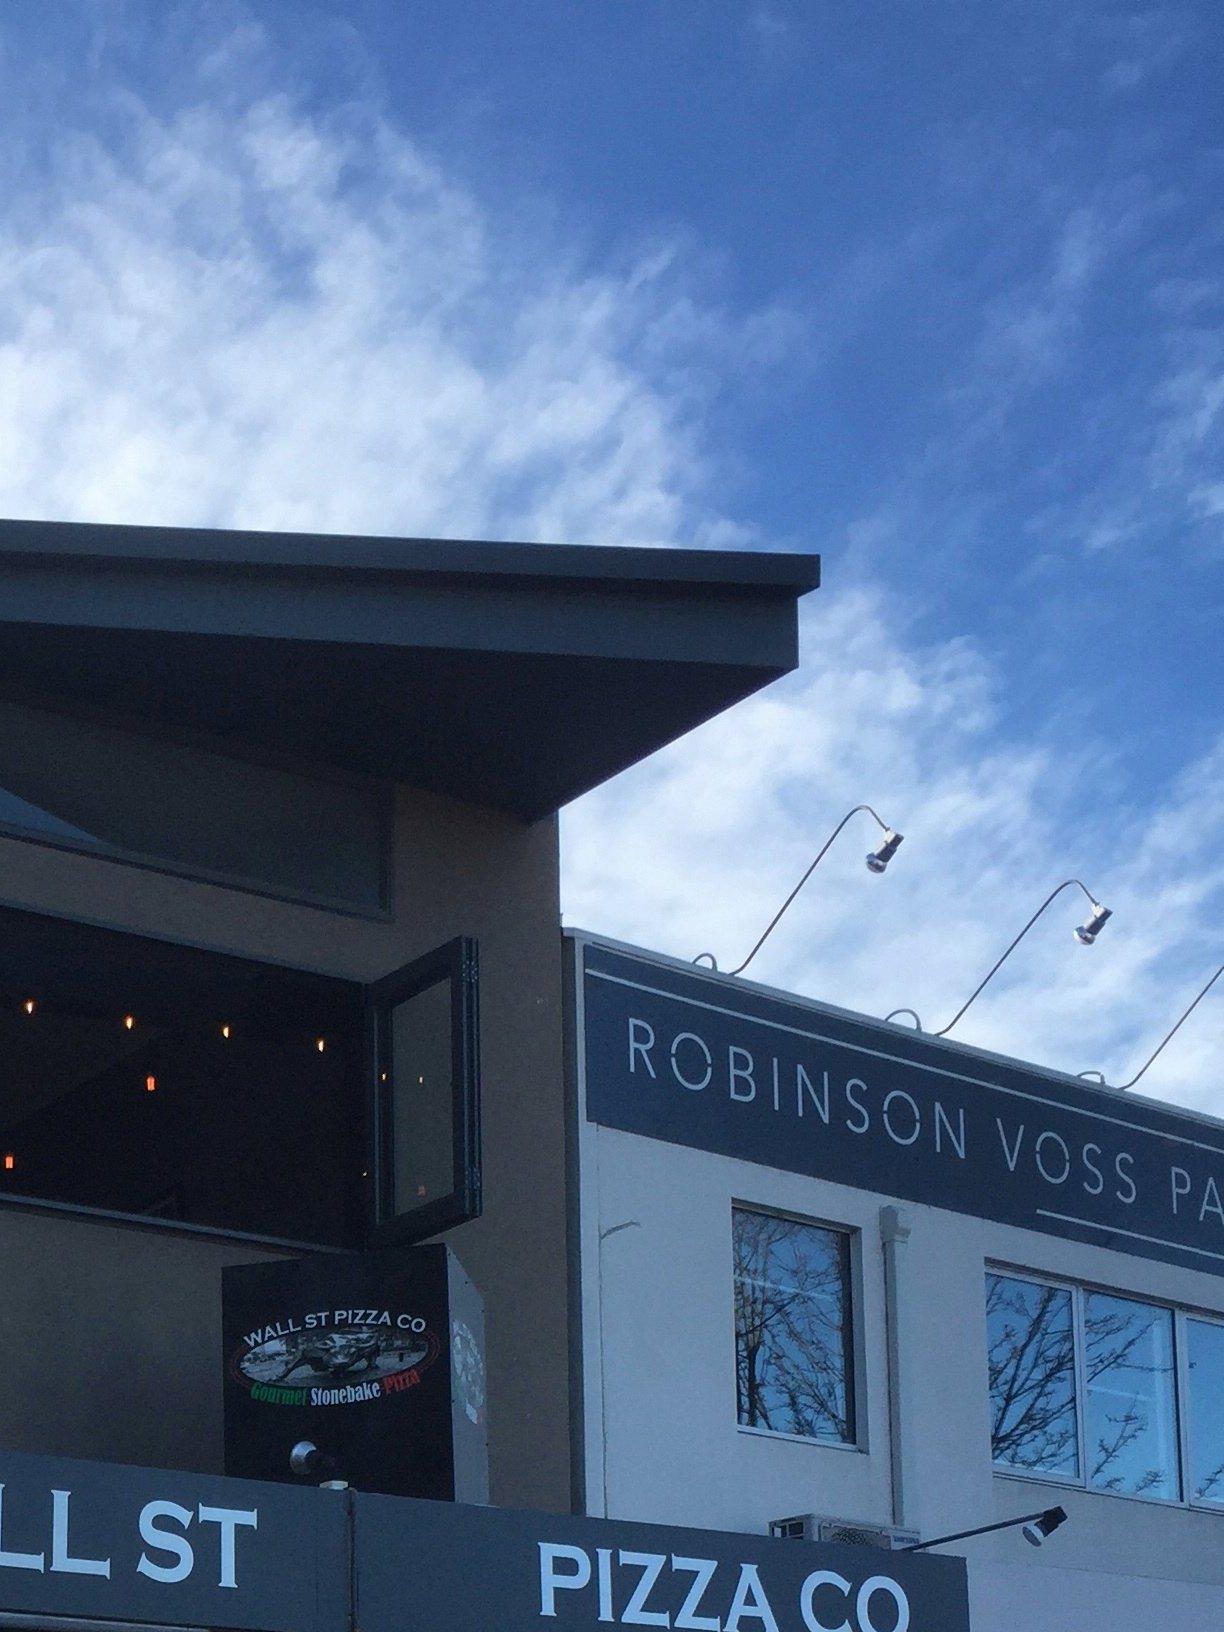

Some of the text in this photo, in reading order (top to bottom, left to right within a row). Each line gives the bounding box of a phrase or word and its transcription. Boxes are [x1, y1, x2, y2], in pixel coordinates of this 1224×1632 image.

[628, 1016, 1224, 1225] ROBINSON VOSS PA
[242, 1309, 426, 1349] WALL ST PIZZA CO
[250, 1381, 308, 1406] Gourmet
[310, 1382, 381, 1407] Stonebake
[136, 1499, 259, 1589] ST
